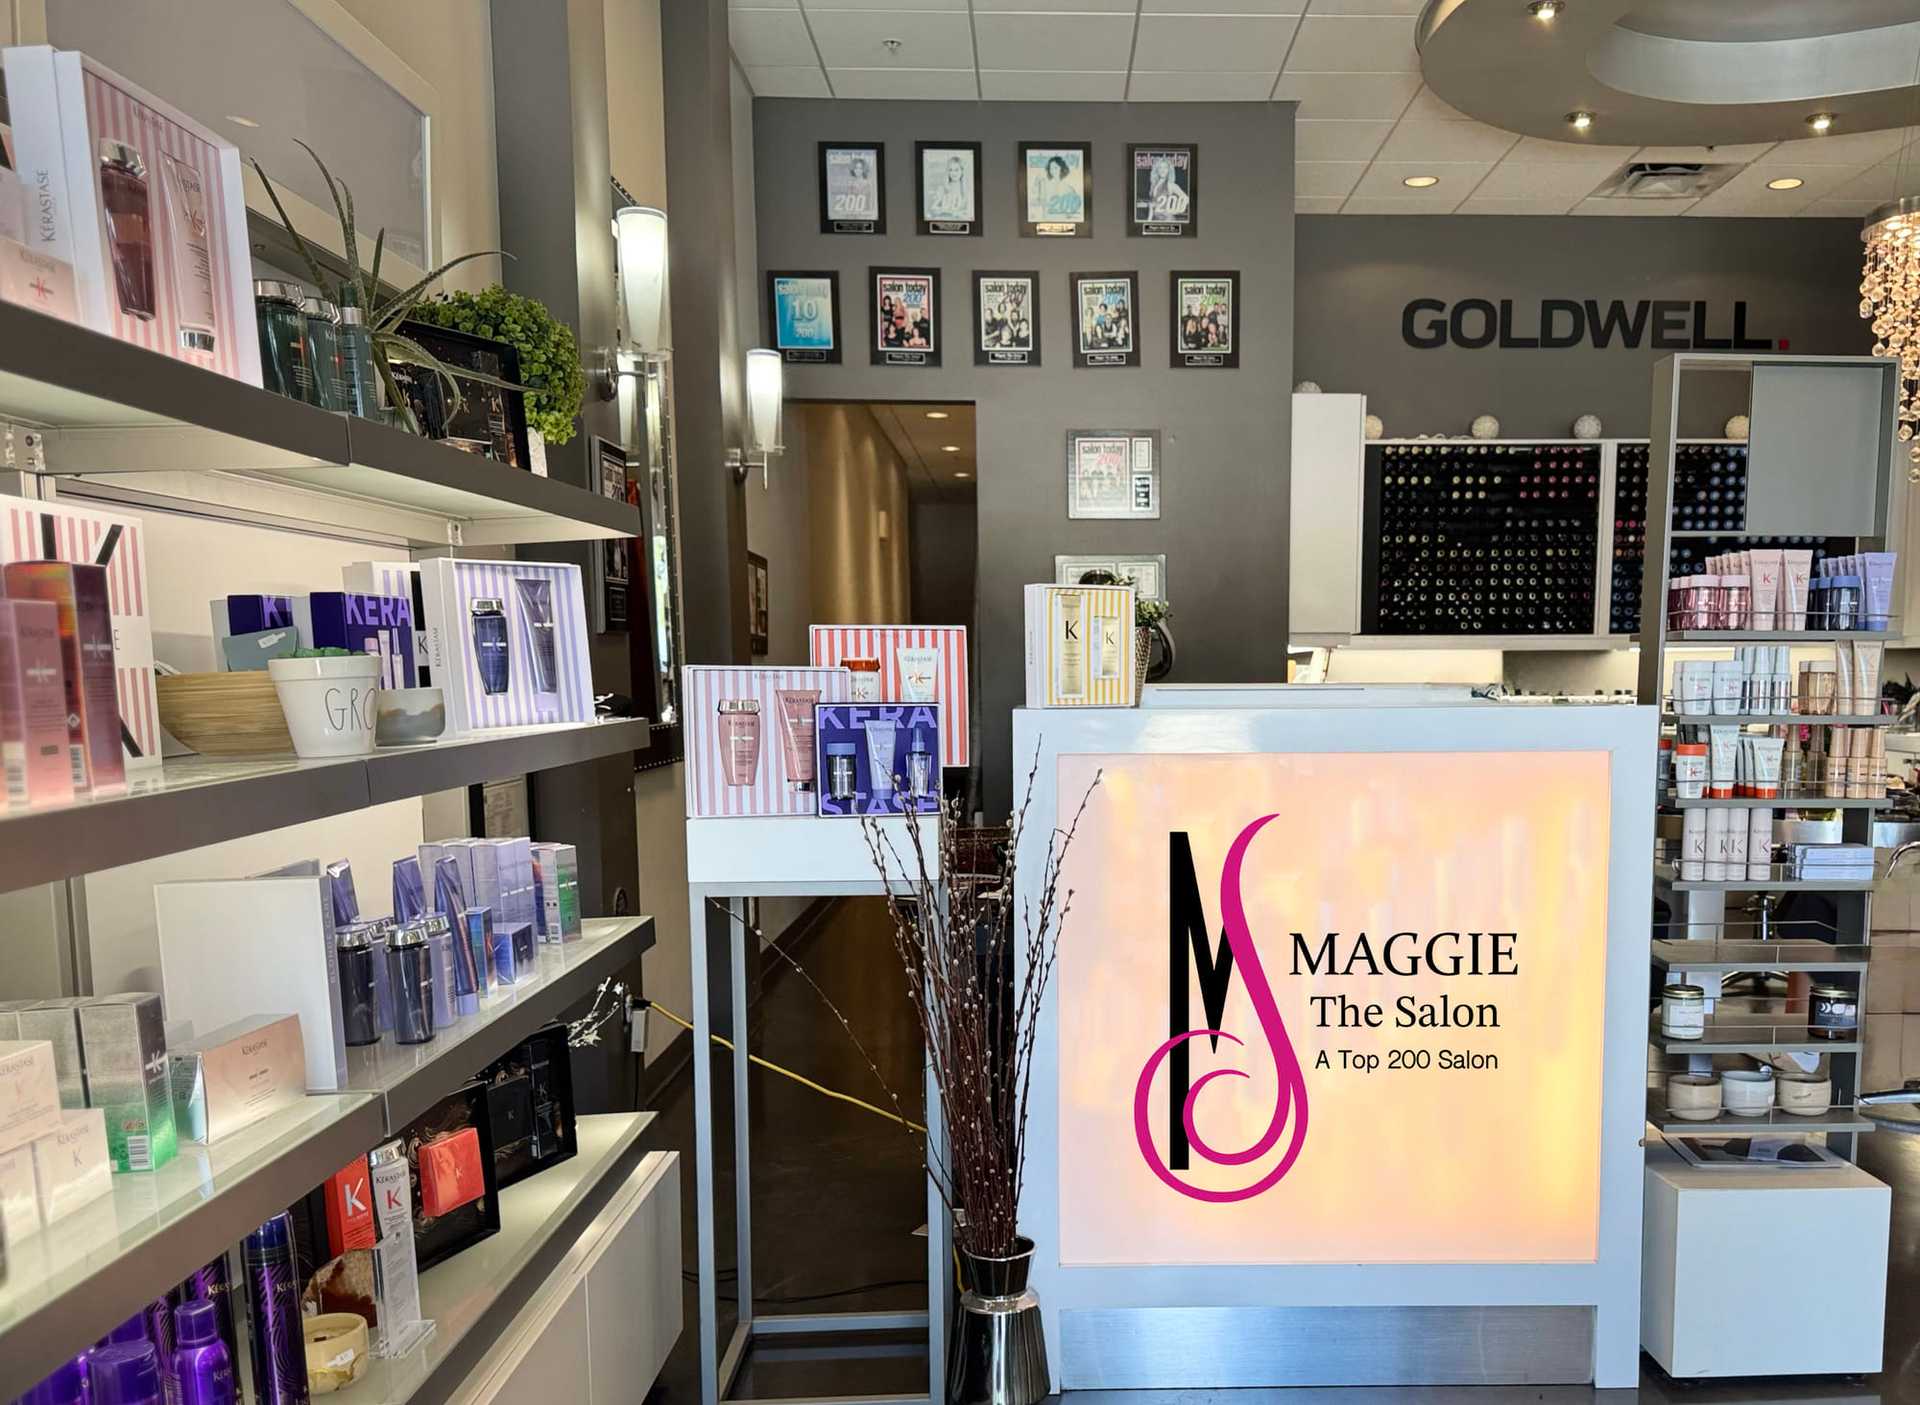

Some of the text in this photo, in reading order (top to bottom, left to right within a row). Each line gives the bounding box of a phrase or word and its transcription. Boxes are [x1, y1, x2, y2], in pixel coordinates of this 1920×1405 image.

[346, 594, 411, 627] KERA
[1066, 620, 1079, 640] K
[819, 707, 938, 730] KERA
[1290, 933, 1518, 976] MAGGIE
[1310, 995, 1500, 1027] The Salon
[1316, 1050, 1497, 1073] A Top 200 Salon
[343, 1176, 368, 1217] K
[386, 1188, 402, 1210] K
